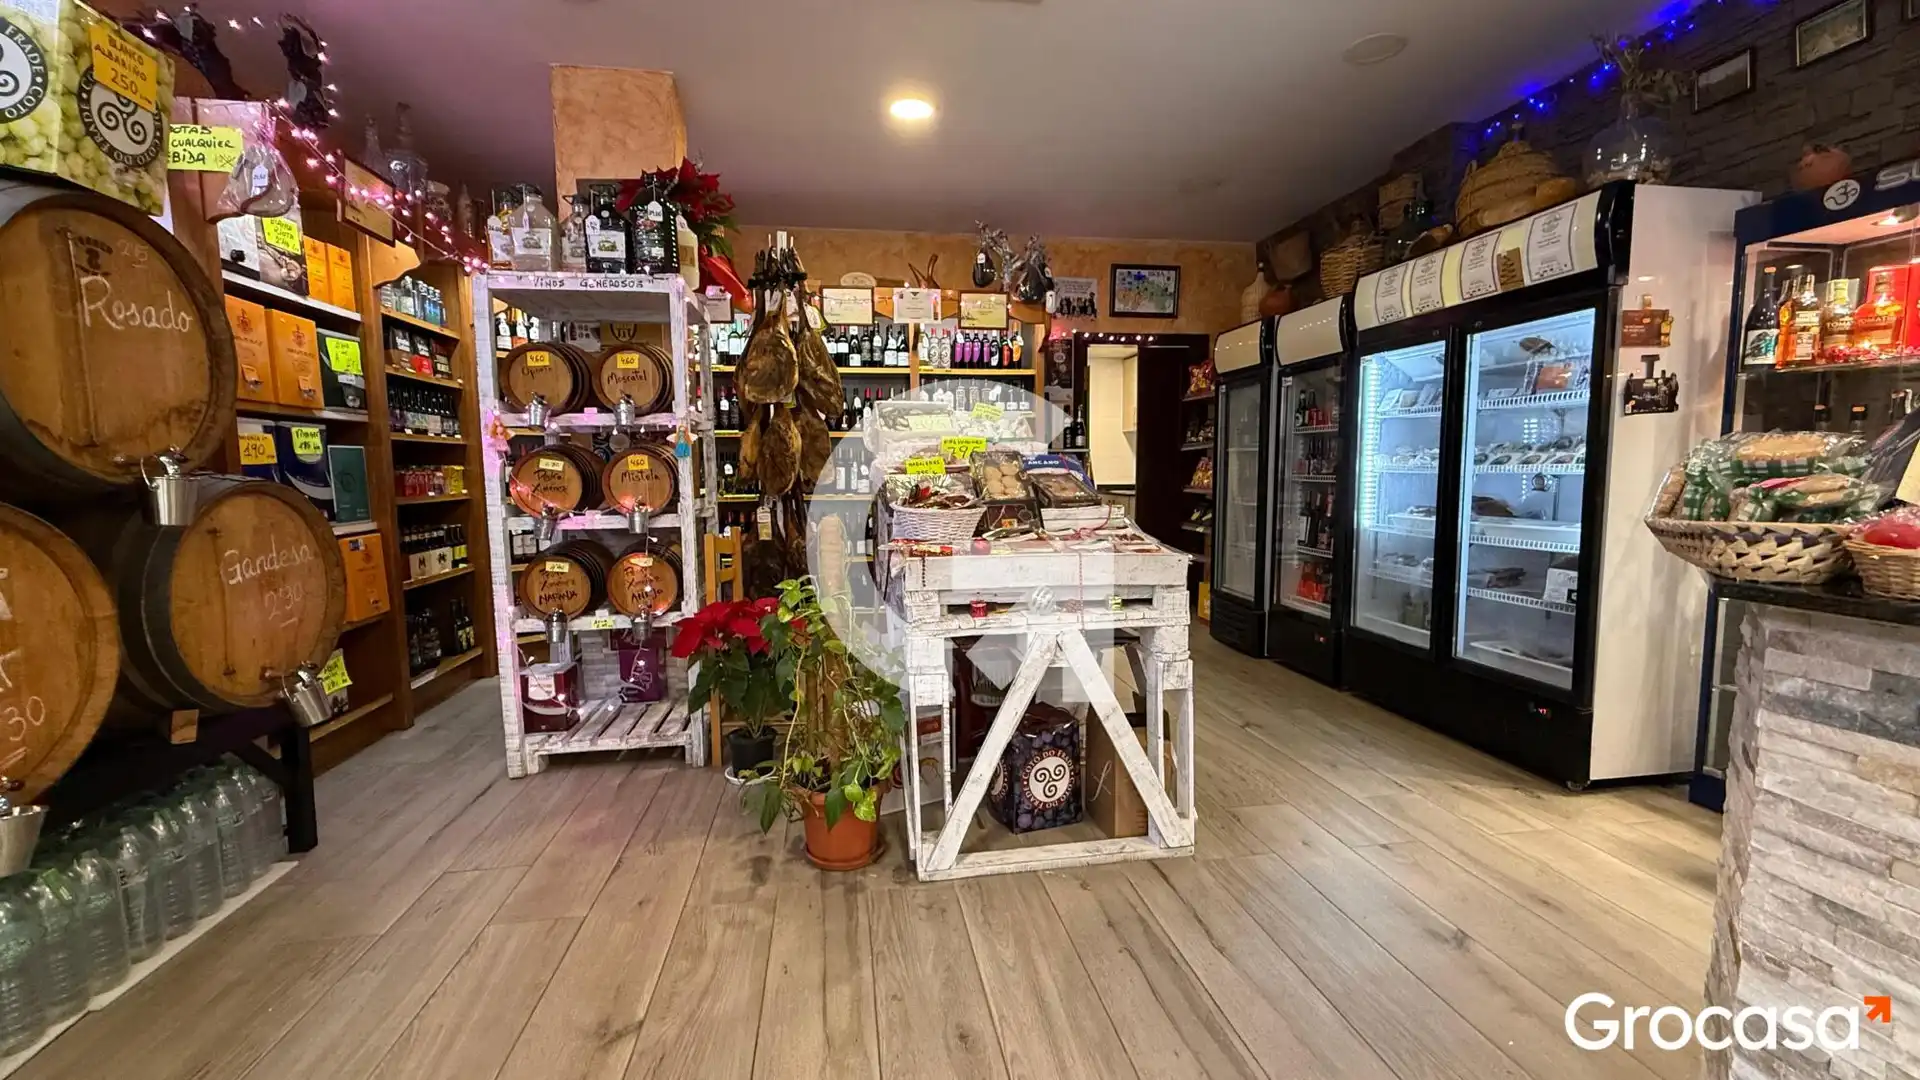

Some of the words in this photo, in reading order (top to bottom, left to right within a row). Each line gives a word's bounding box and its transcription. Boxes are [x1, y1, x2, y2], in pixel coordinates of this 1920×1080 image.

[5, 25, 45, 74] FRADE
[110, 67, 138, 95] 250
[4, 86, 43, 119] COTO
[171, 137, 236, 149] CUALQUIER
[79, 275, 194, 333] Rosado
[222, 534, 315, 585] Gandesa
